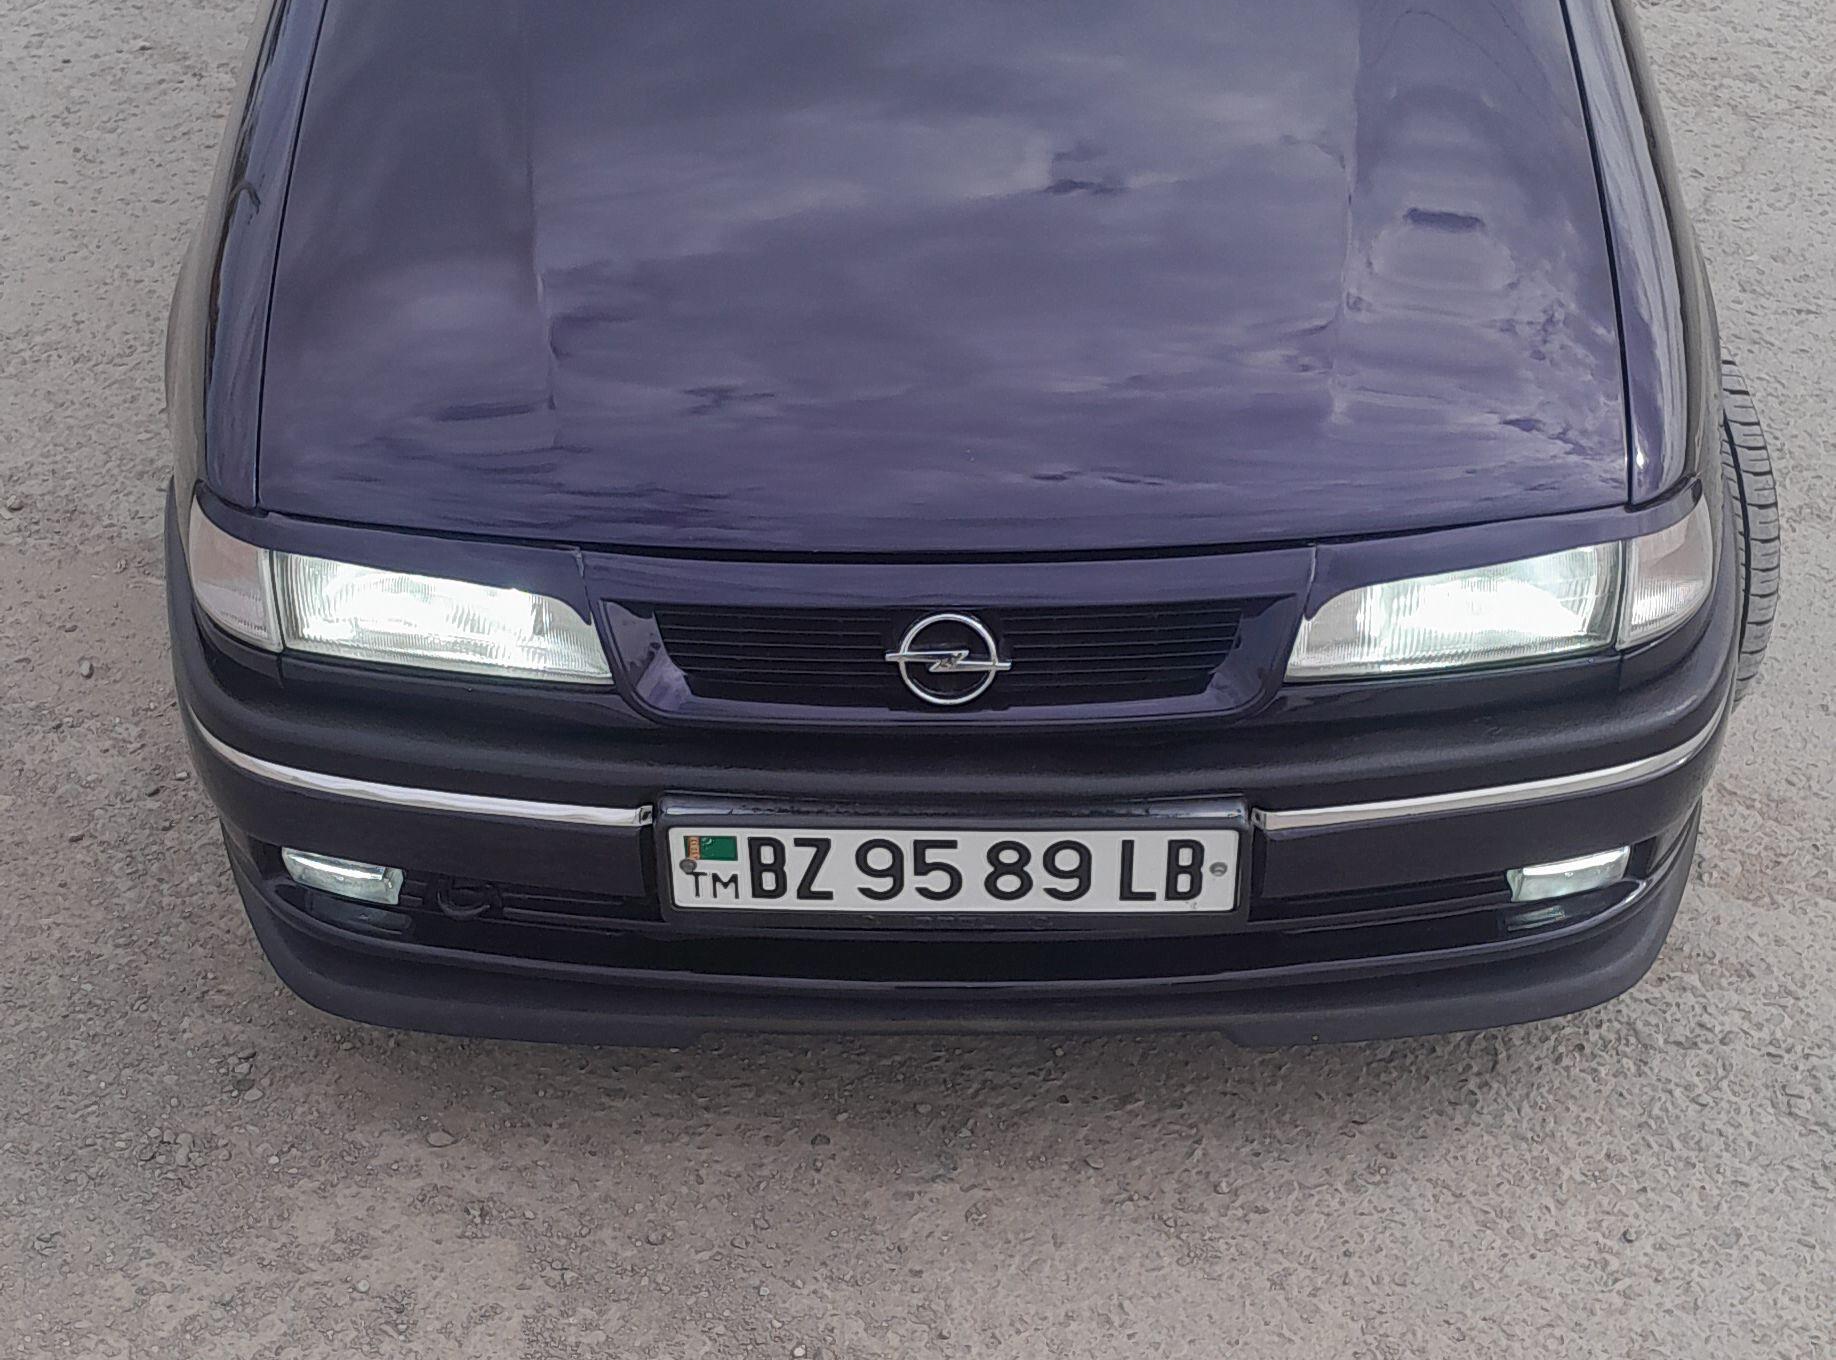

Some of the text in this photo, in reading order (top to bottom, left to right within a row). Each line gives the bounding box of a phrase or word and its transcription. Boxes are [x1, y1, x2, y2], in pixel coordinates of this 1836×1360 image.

[684, 871, 739, 899] TM
[747, 836, 1205, 902] BZ 95 89 LB
